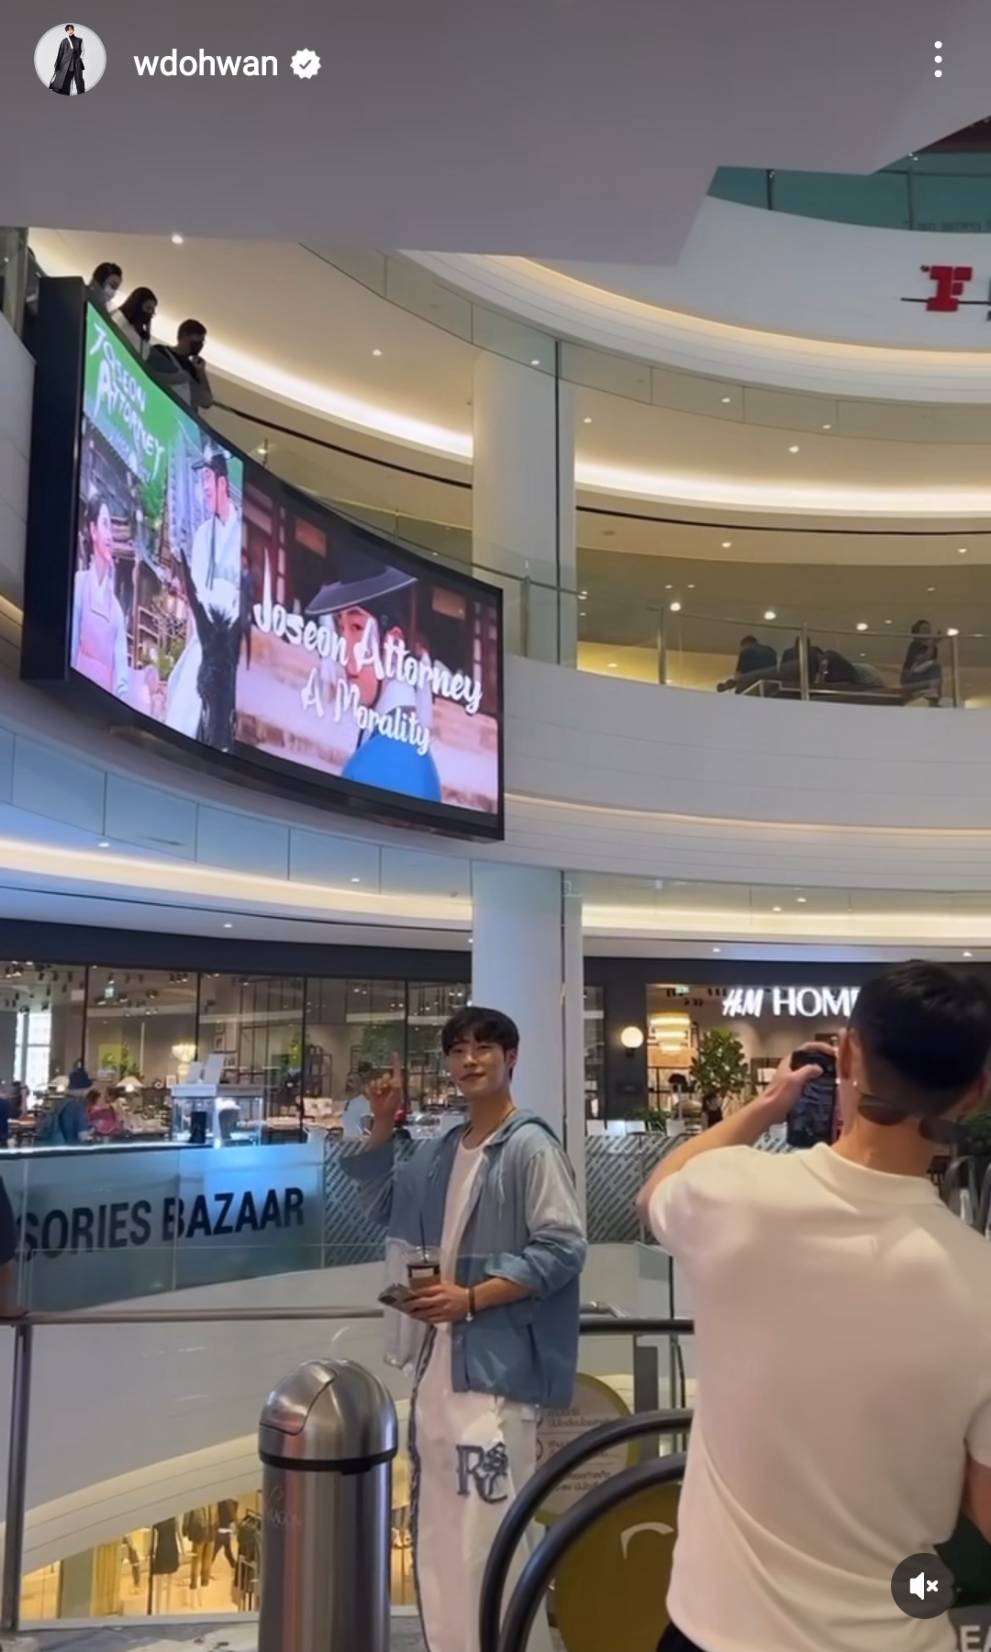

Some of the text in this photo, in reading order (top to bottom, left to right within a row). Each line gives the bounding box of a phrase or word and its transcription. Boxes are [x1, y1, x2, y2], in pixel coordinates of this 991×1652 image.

[253, 547, 483, 714] Joseon Attorney
[301, 667, 431, 756] A Morality
[772, 985, 861, 1018] HOM
[162, 1186, 305, 1242] BAZAAR
